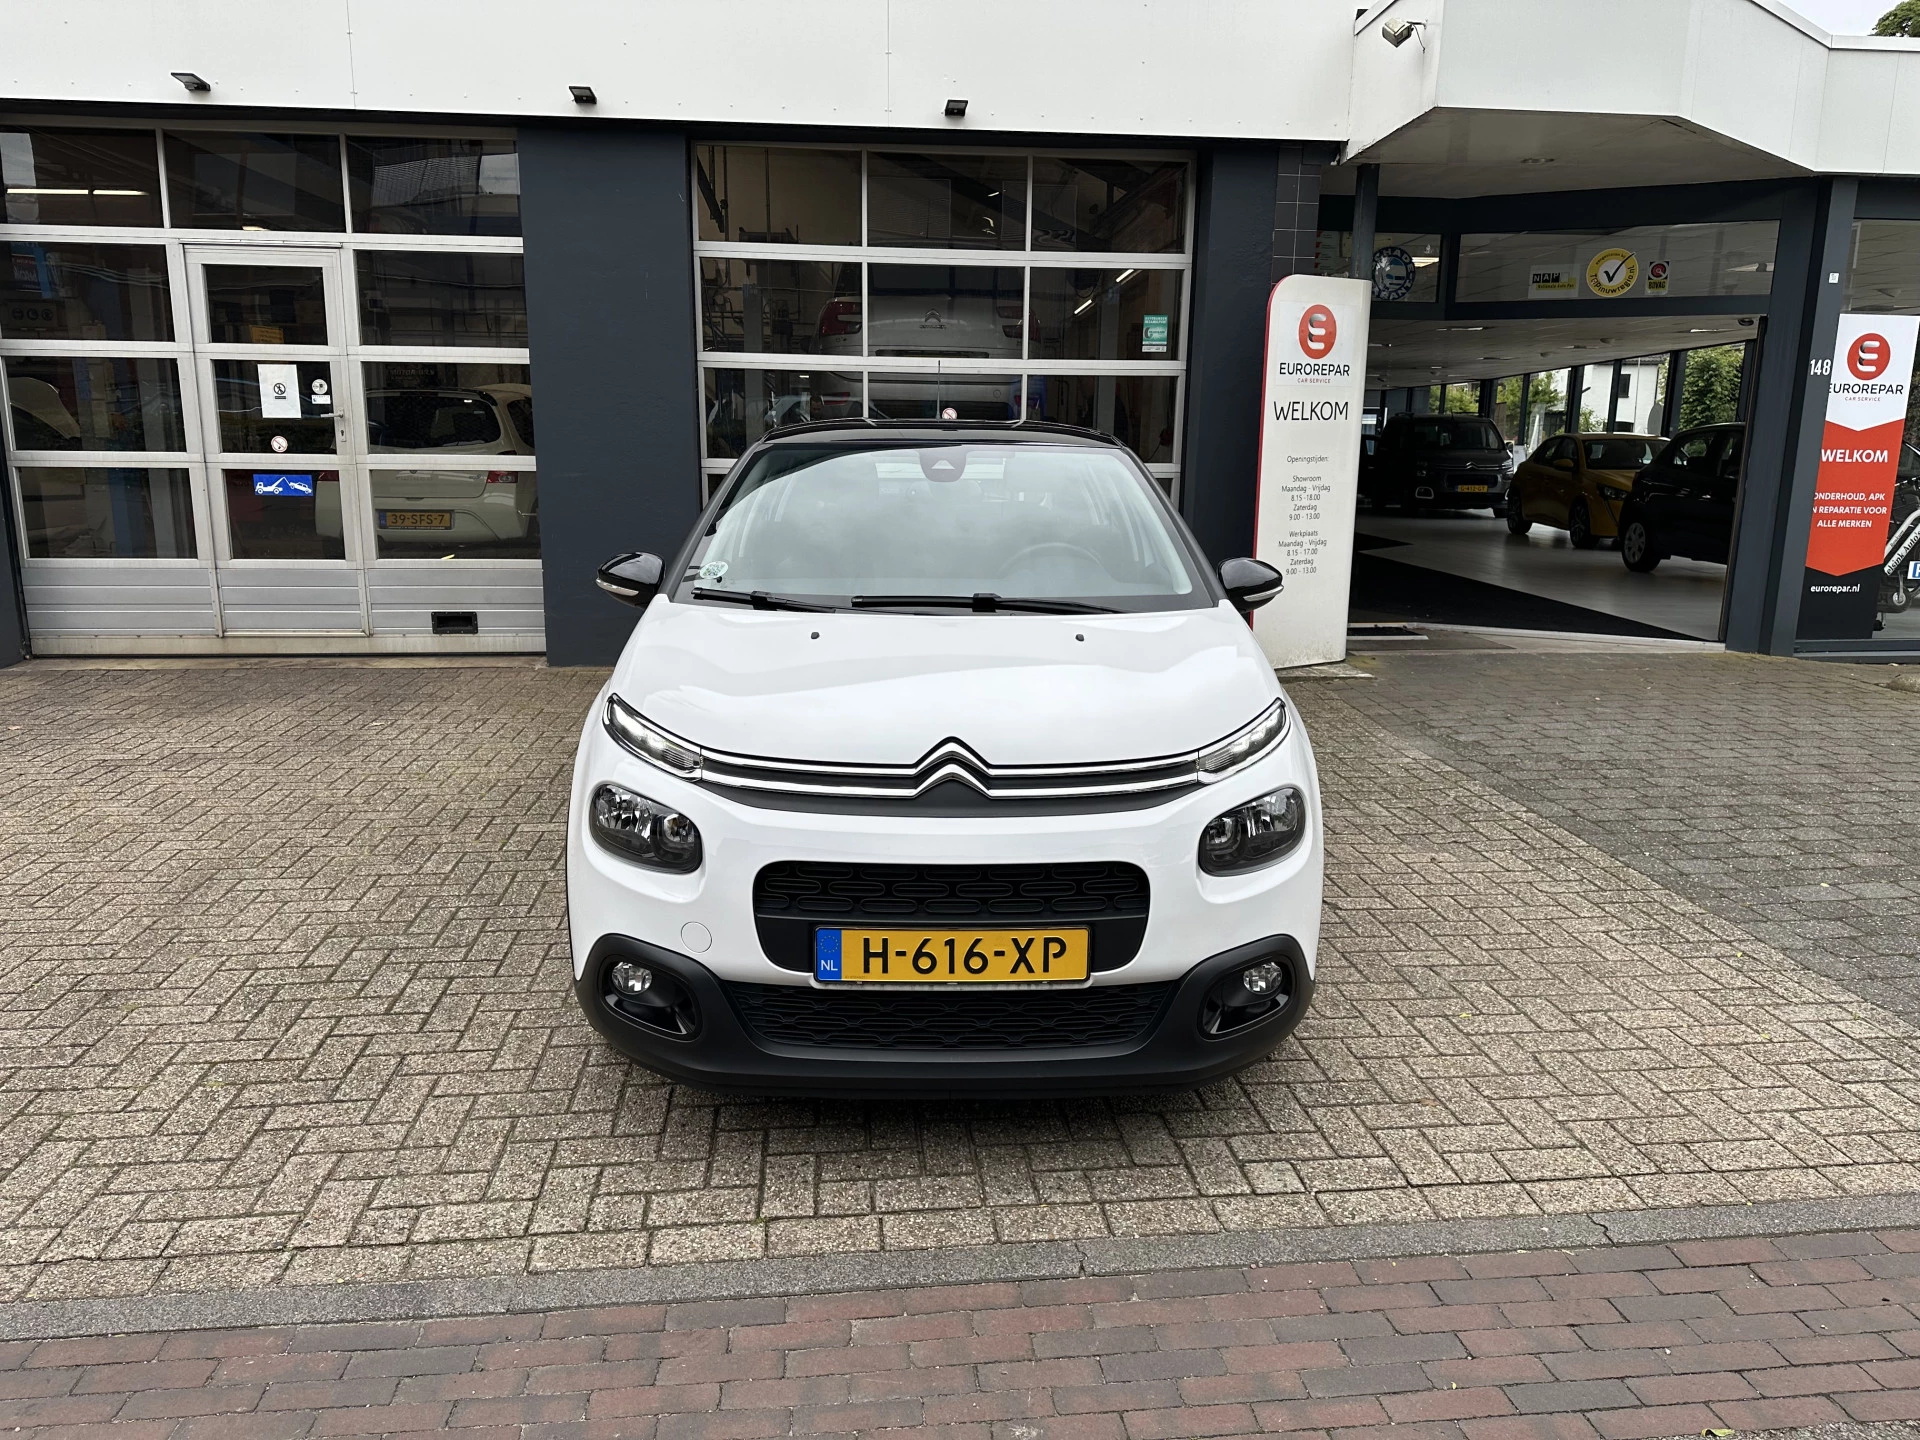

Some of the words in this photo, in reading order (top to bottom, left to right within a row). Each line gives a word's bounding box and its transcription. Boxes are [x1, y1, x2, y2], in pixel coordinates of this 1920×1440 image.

[1532, 273, 1560, 283] NAP
[1648, 281, 1666, 289] BOVAG
[1279, 362, 1350, 376] EUROREPAR
[1810, 359, 1831, 376] 148
[1273, 401, 1349, 420] WELKOM
[1821, 449, 1888, 462] WELKOM
[1281, 485, 1307, 494] Maandag
[1312, 484, 1330, 492] Vrijdag
[1293, 504, 1317, 512] Zaterdag
[1818, 506, 1862, 514] REPARATIE
[391, 514, 445, 524] 39-SFS-7
[1816, 520, 1836, 528] ALLE
[1838, 520, 1872, 528] MERKEN
[1289, 530, 1318, 538] Werkplaats
[1278, 540, 1304, 548] Maandag
[1308, 539, 1328, 547] Vrijdag
[1290, 558, 1314, 566] Zaterdag
[1810, 584, 1860, 594] eurorepar.nl
[862, 938, 1068, 974] H-616-XP
[820, 960, 838, 971] NL
